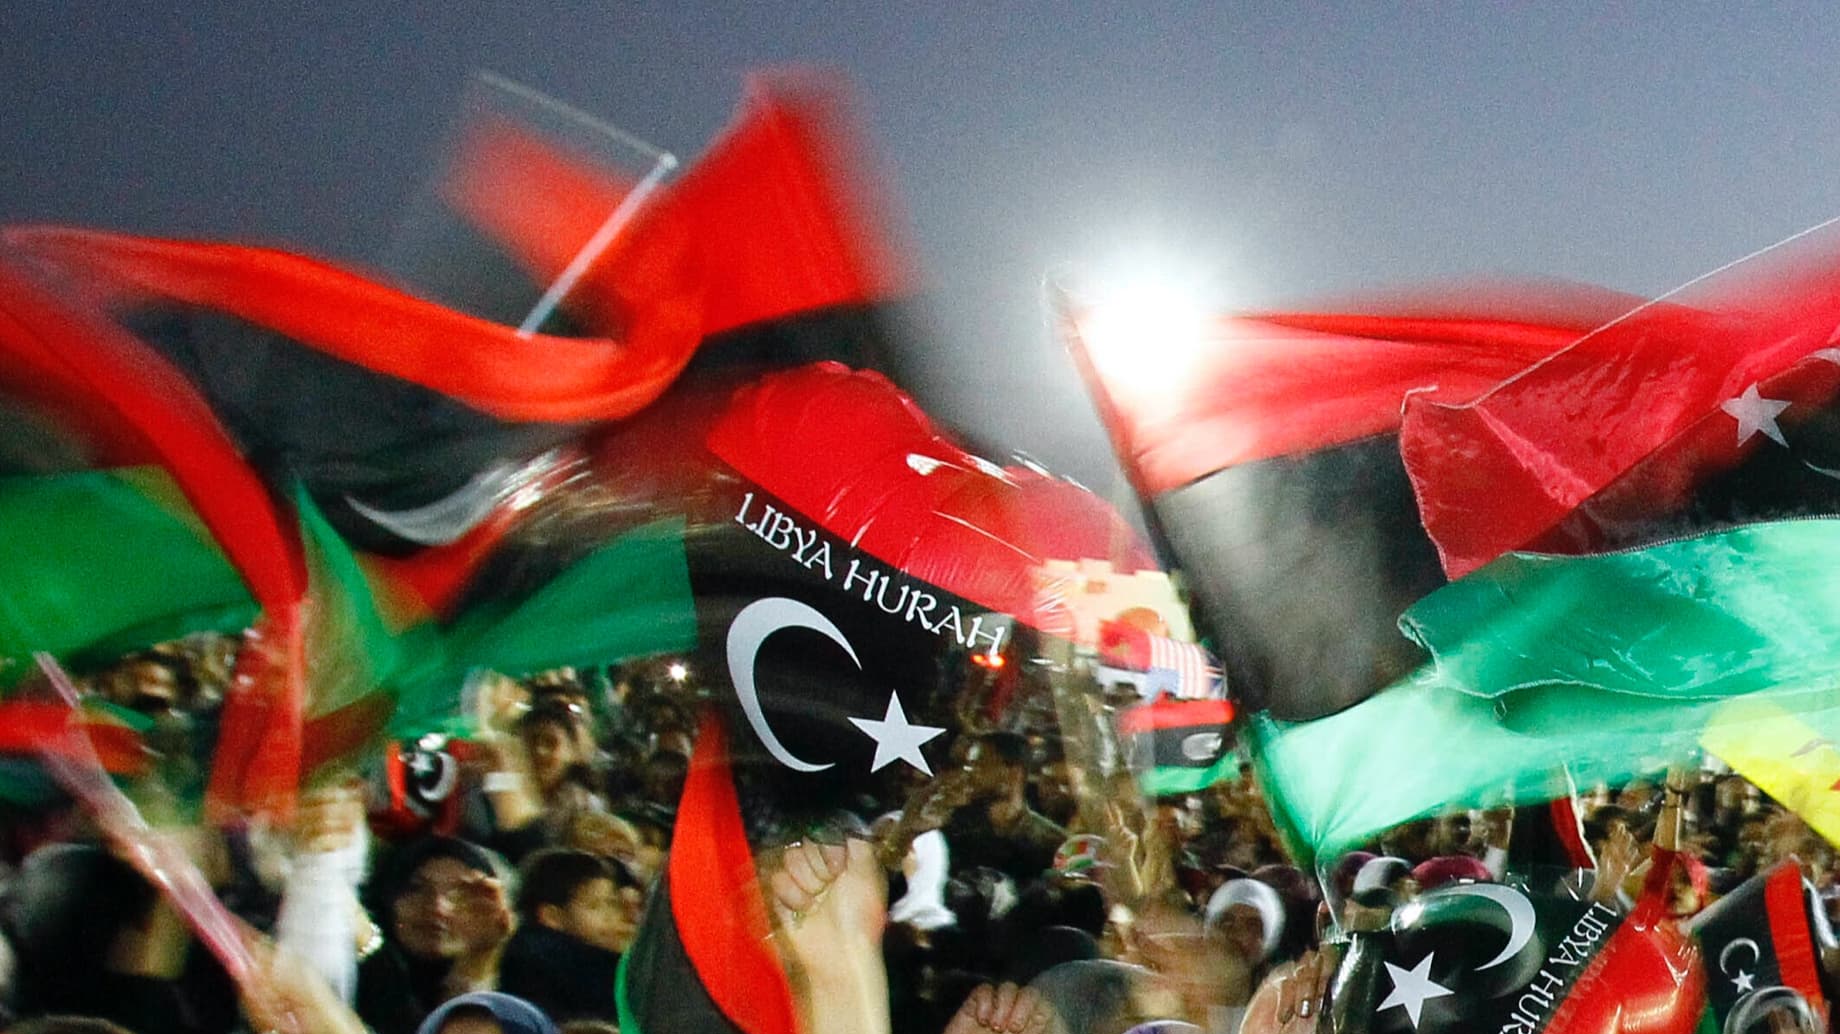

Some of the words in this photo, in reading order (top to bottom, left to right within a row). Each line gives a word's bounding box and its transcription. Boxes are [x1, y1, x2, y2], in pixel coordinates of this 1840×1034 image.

[734, 492, 834, 580] LIBYA
[843, 559, 1006, 658] HURAH
[1549, 901, 1618, 966] LIBYA
